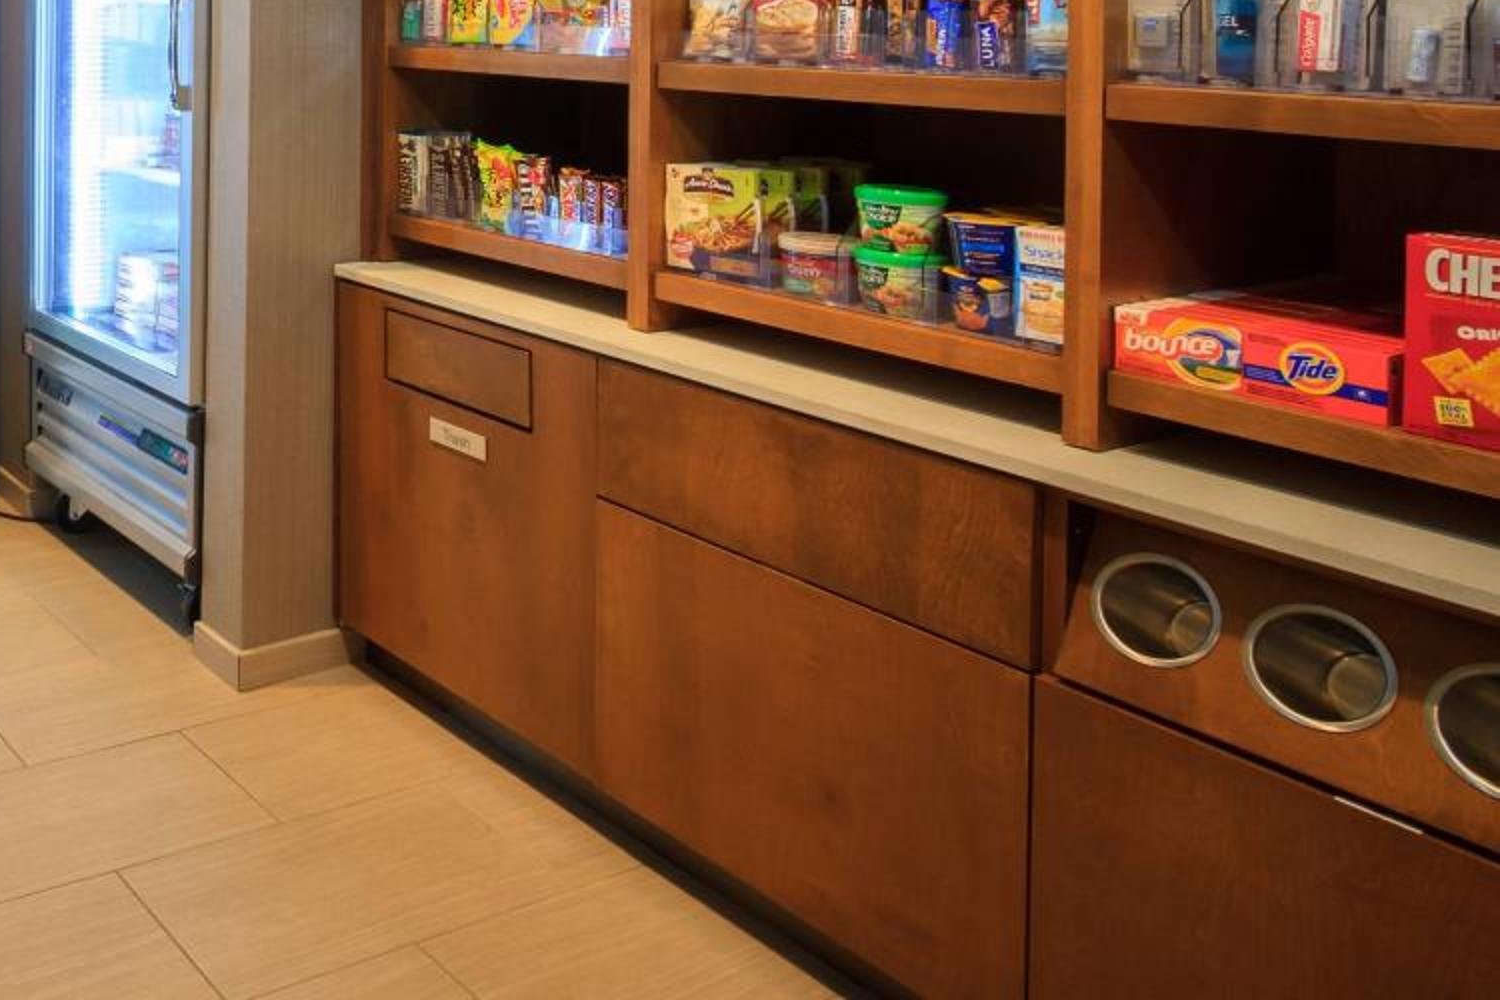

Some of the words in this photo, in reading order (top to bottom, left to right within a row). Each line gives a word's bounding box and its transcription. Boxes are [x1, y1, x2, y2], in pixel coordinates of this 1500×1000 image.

[981, 26, 997, 68] LUNA
[1125, 326, 1215, 356] bounce
[1457, 325, 1500, 342] ORI
[1287, 353, 1339, 380] Tide
